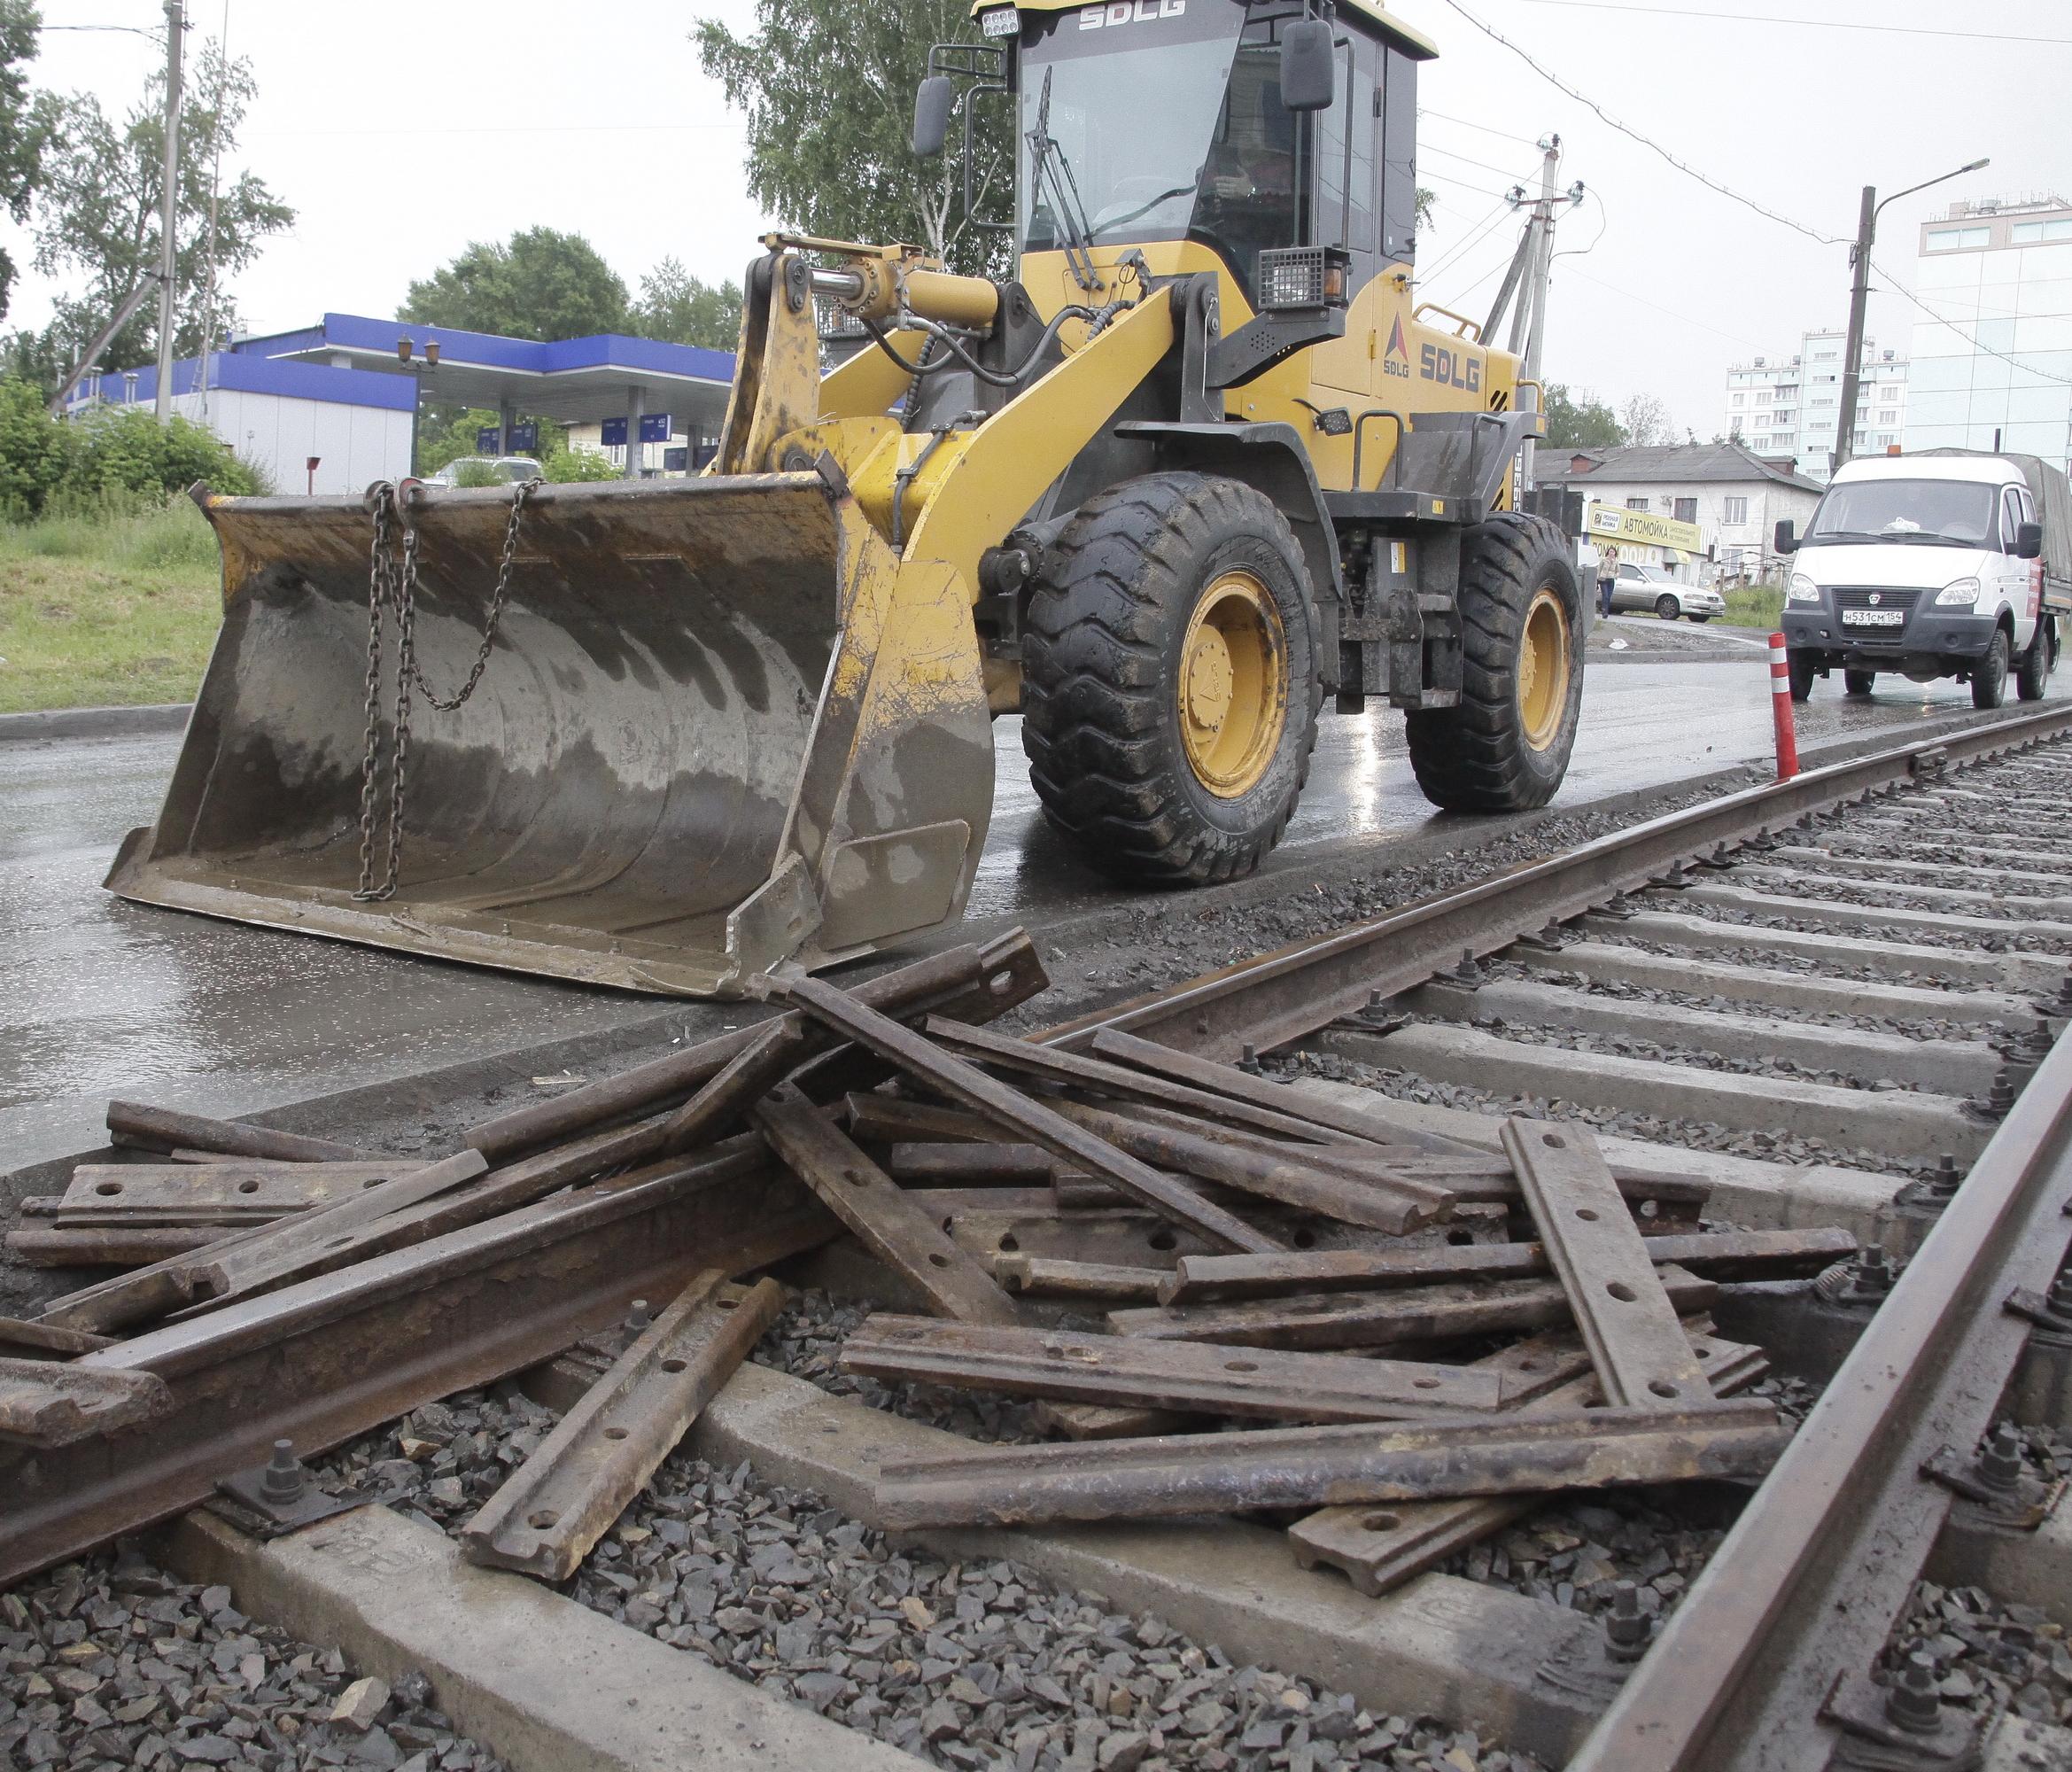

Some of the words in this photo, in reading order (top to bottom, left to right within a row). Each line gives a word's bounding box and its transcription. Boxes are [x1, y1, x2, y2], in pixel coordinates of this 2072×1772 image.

[1079, 0, 1185, 30] SDLG
[1384, 360, 1409, 378] SDLG
[1420, 343, 1480, 393] SDLG
[1624, 517, 1669, 540] АВТОМОЙКА
